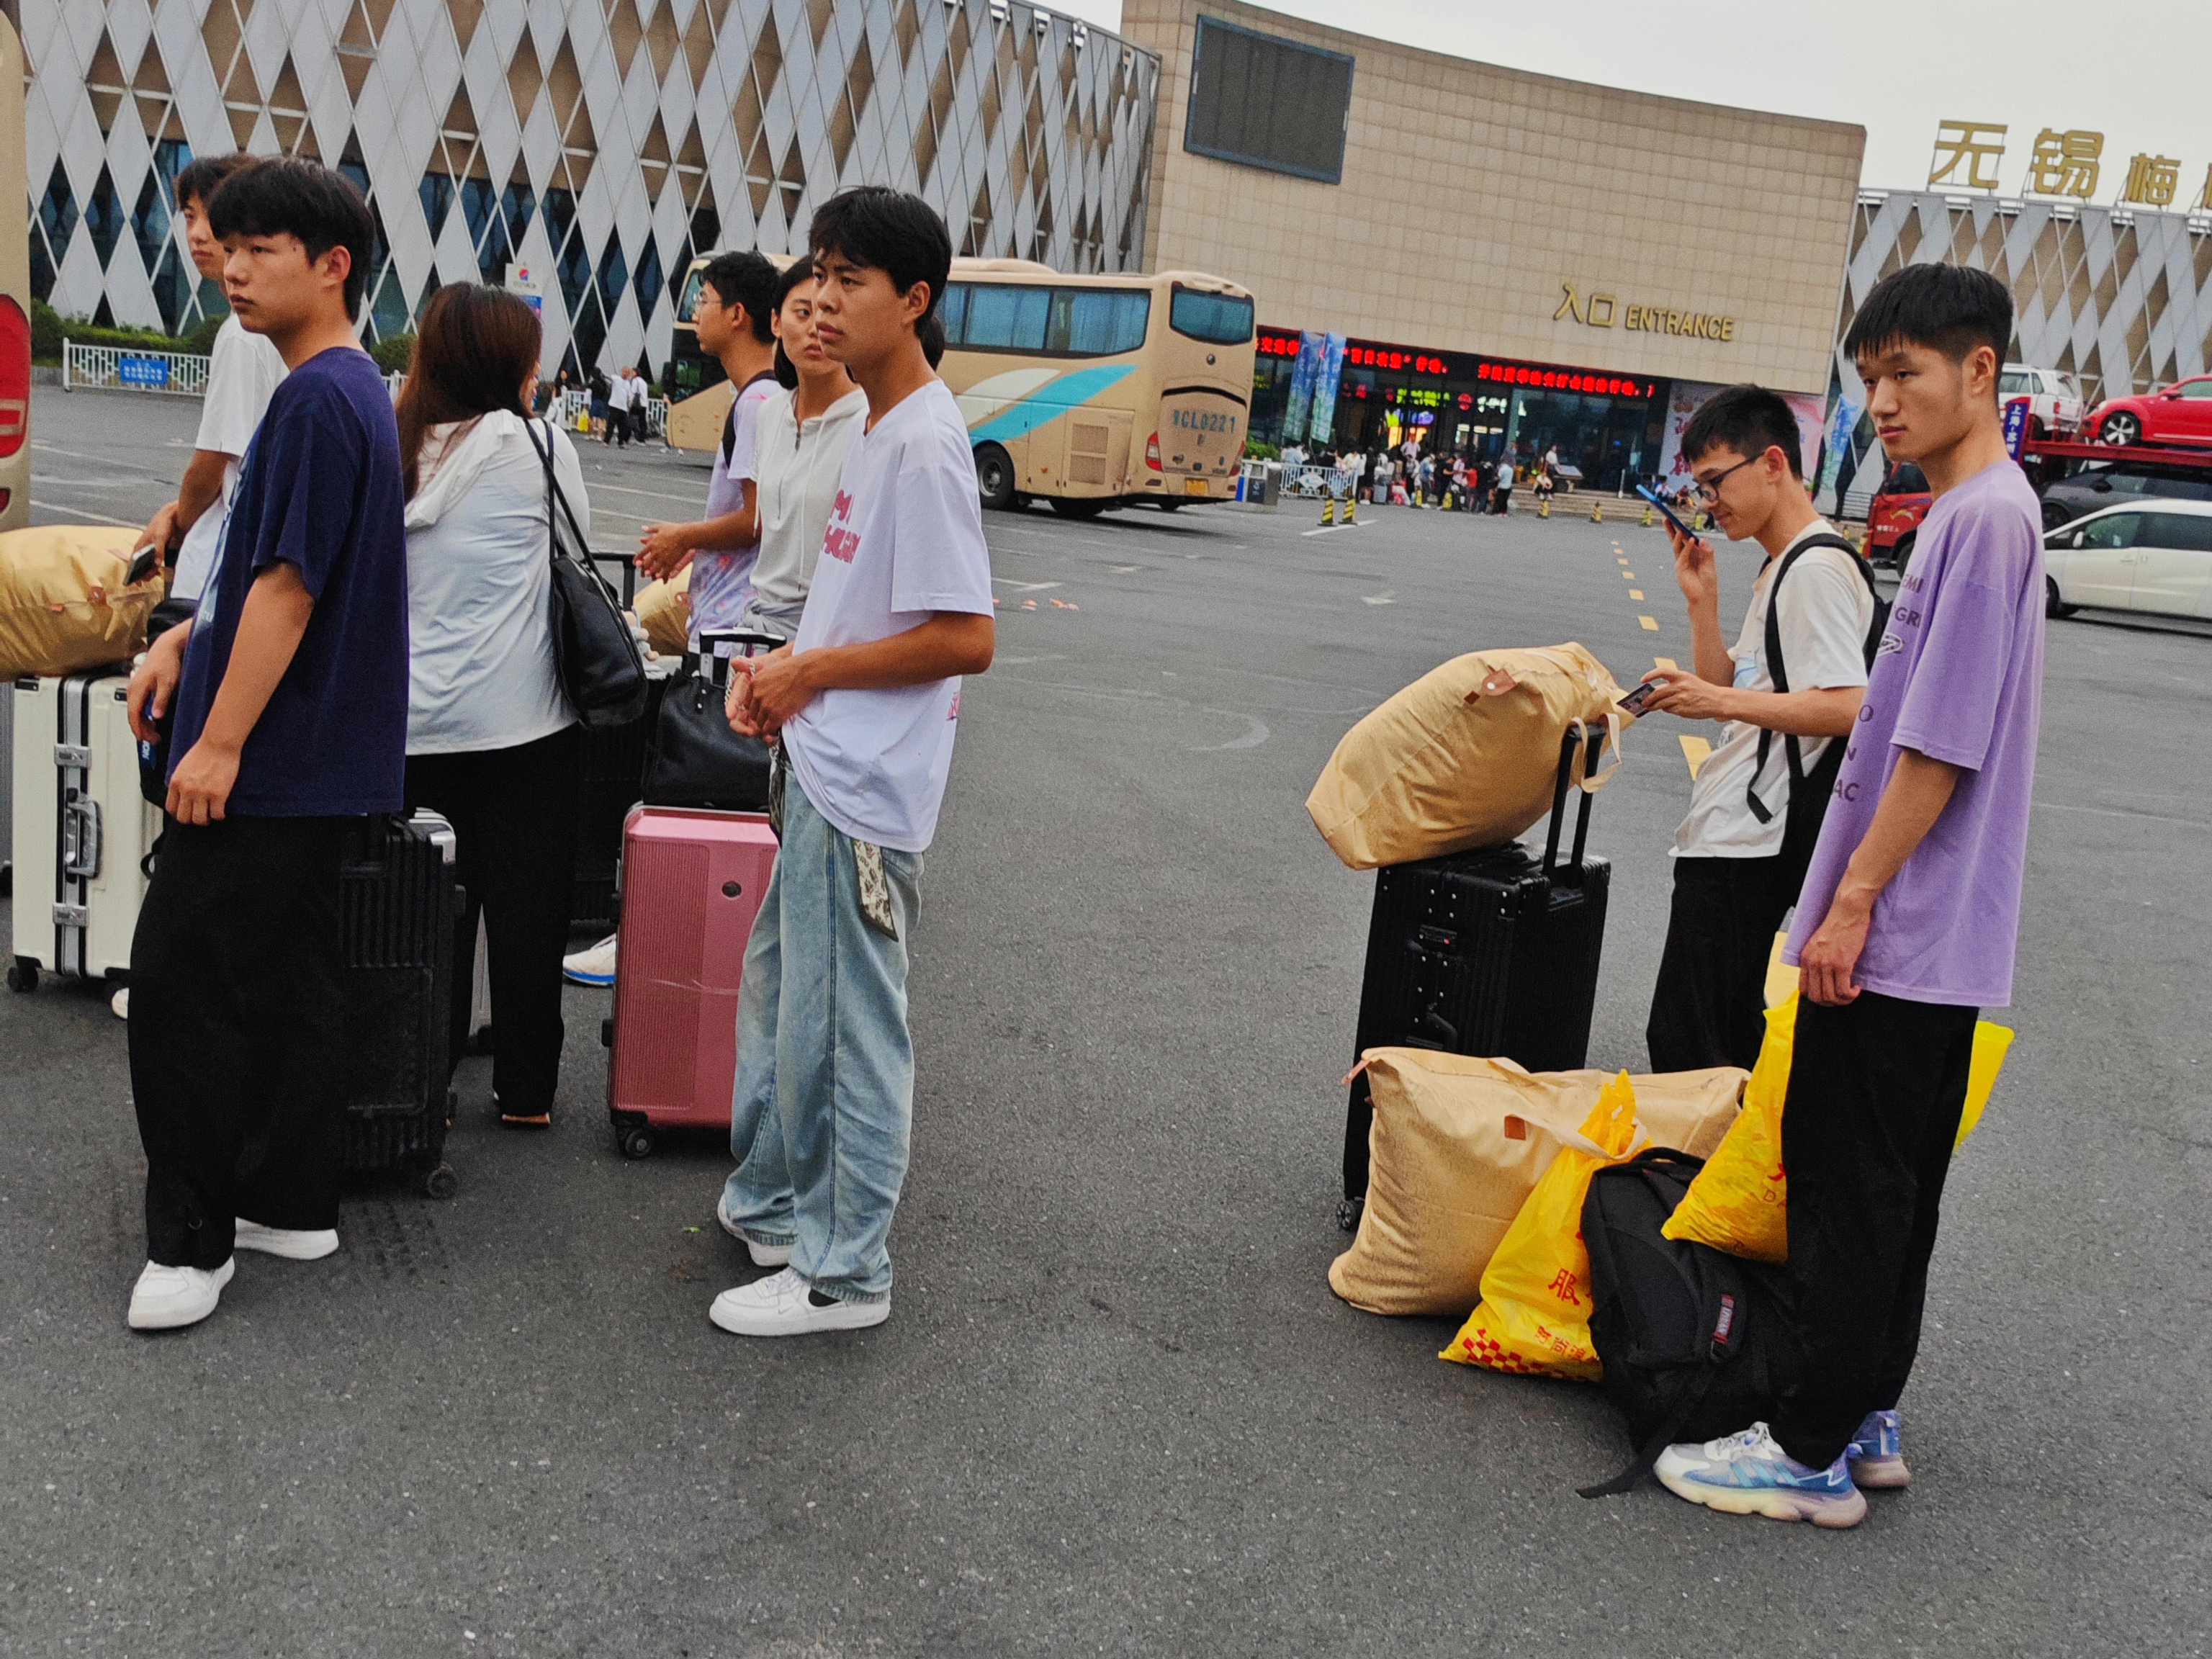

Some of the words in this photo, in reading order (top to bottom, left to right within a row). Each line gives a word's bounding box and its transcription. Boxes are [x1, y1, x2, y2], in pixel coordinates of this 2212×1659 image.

[1929, 120, 2212, 210] 无锡梅
[1552, 283, 1618, 328] 入口
[1624, 304, 1735, 341] ENTRANCE
